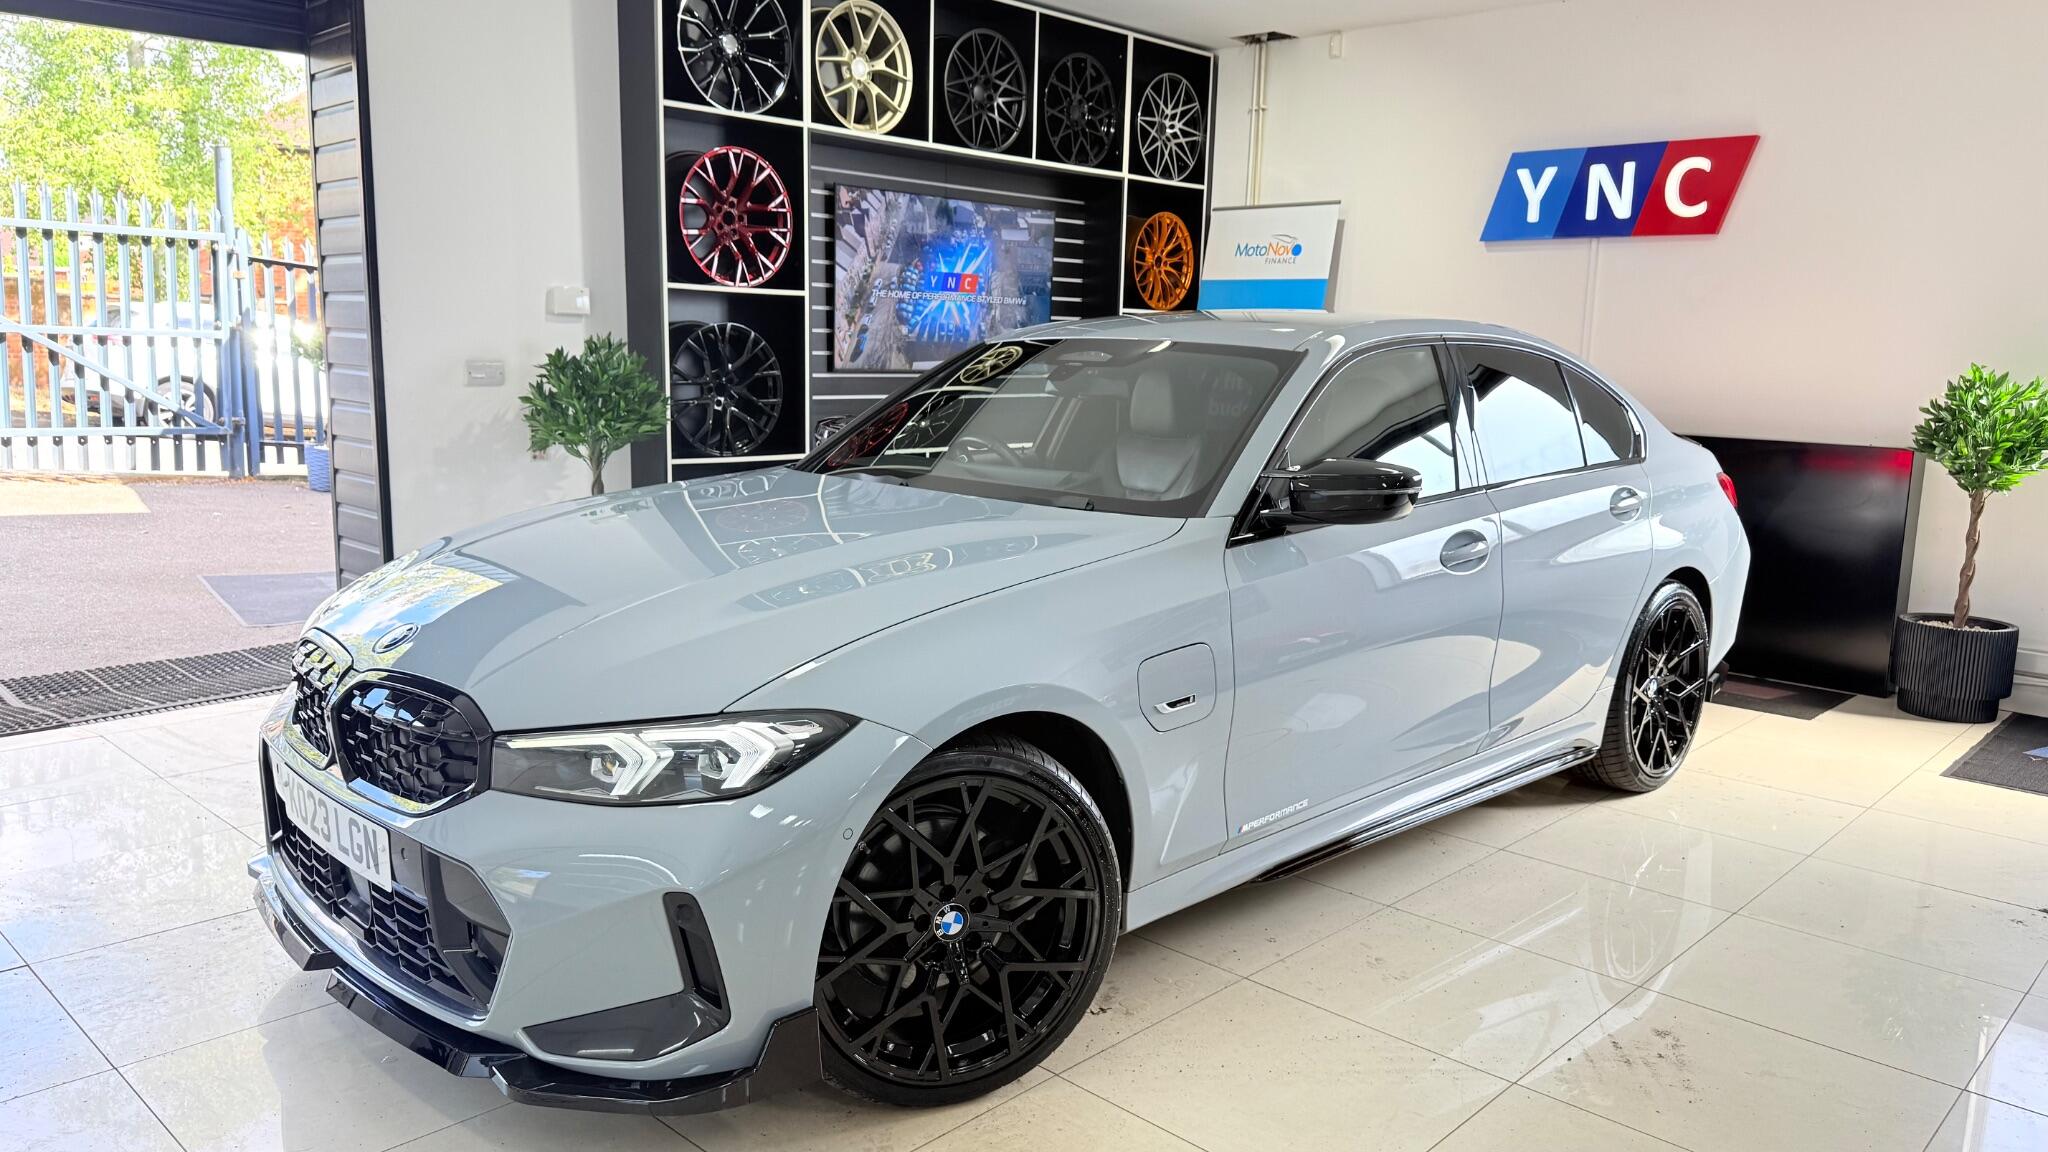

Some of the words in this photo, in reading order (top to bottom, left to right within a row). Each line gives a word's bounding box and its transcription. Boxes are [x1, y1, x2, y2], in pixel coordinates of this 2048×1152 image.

[1516, 156, 1713, 224] YNC
[1264, 257, 1297, 265] FINANCE
[930, 275, 972, 290] YNC
[872, 289, 888, 298] THE
[888, 290, 911, 299] HOME
[912, 292, 923, 300] OF
[923, 293, 977, 303] PERFORMANCE
[977, 295, 1003, 304] STYLED
[334, 807, 380, 876] LGN
